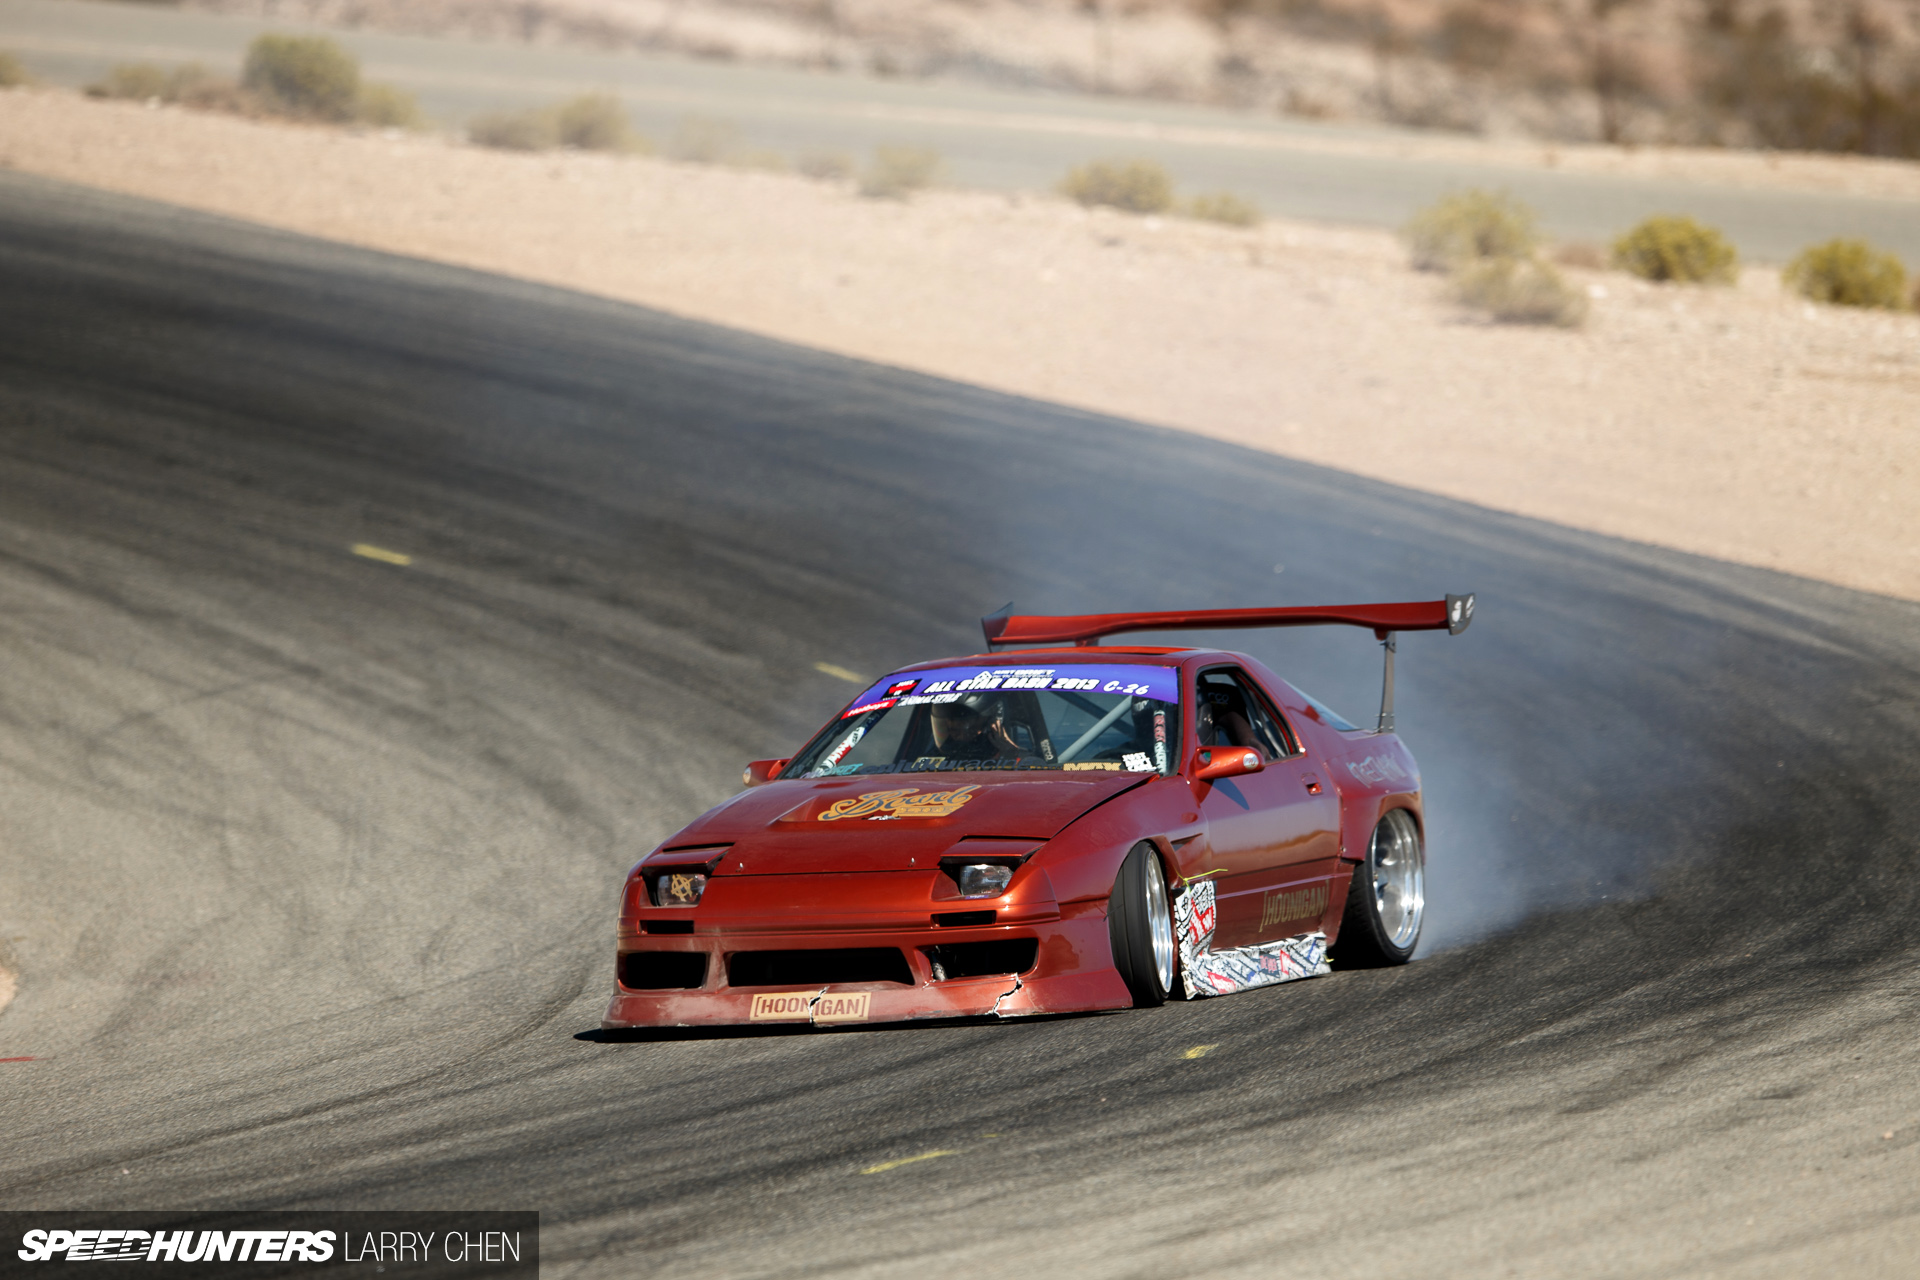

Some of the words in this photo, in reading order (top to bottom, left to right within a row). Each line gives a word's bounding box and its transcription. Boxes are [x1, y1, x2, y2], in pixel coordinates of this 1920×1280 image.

[924, 680, 957, 694] ALL
[955, 677, 1004, 691] STAR
[1000, 677, 1054, 689] BASH
[1050, 677, 1100, 690] 2013
[1103, 680, 1150, 695] C-26
